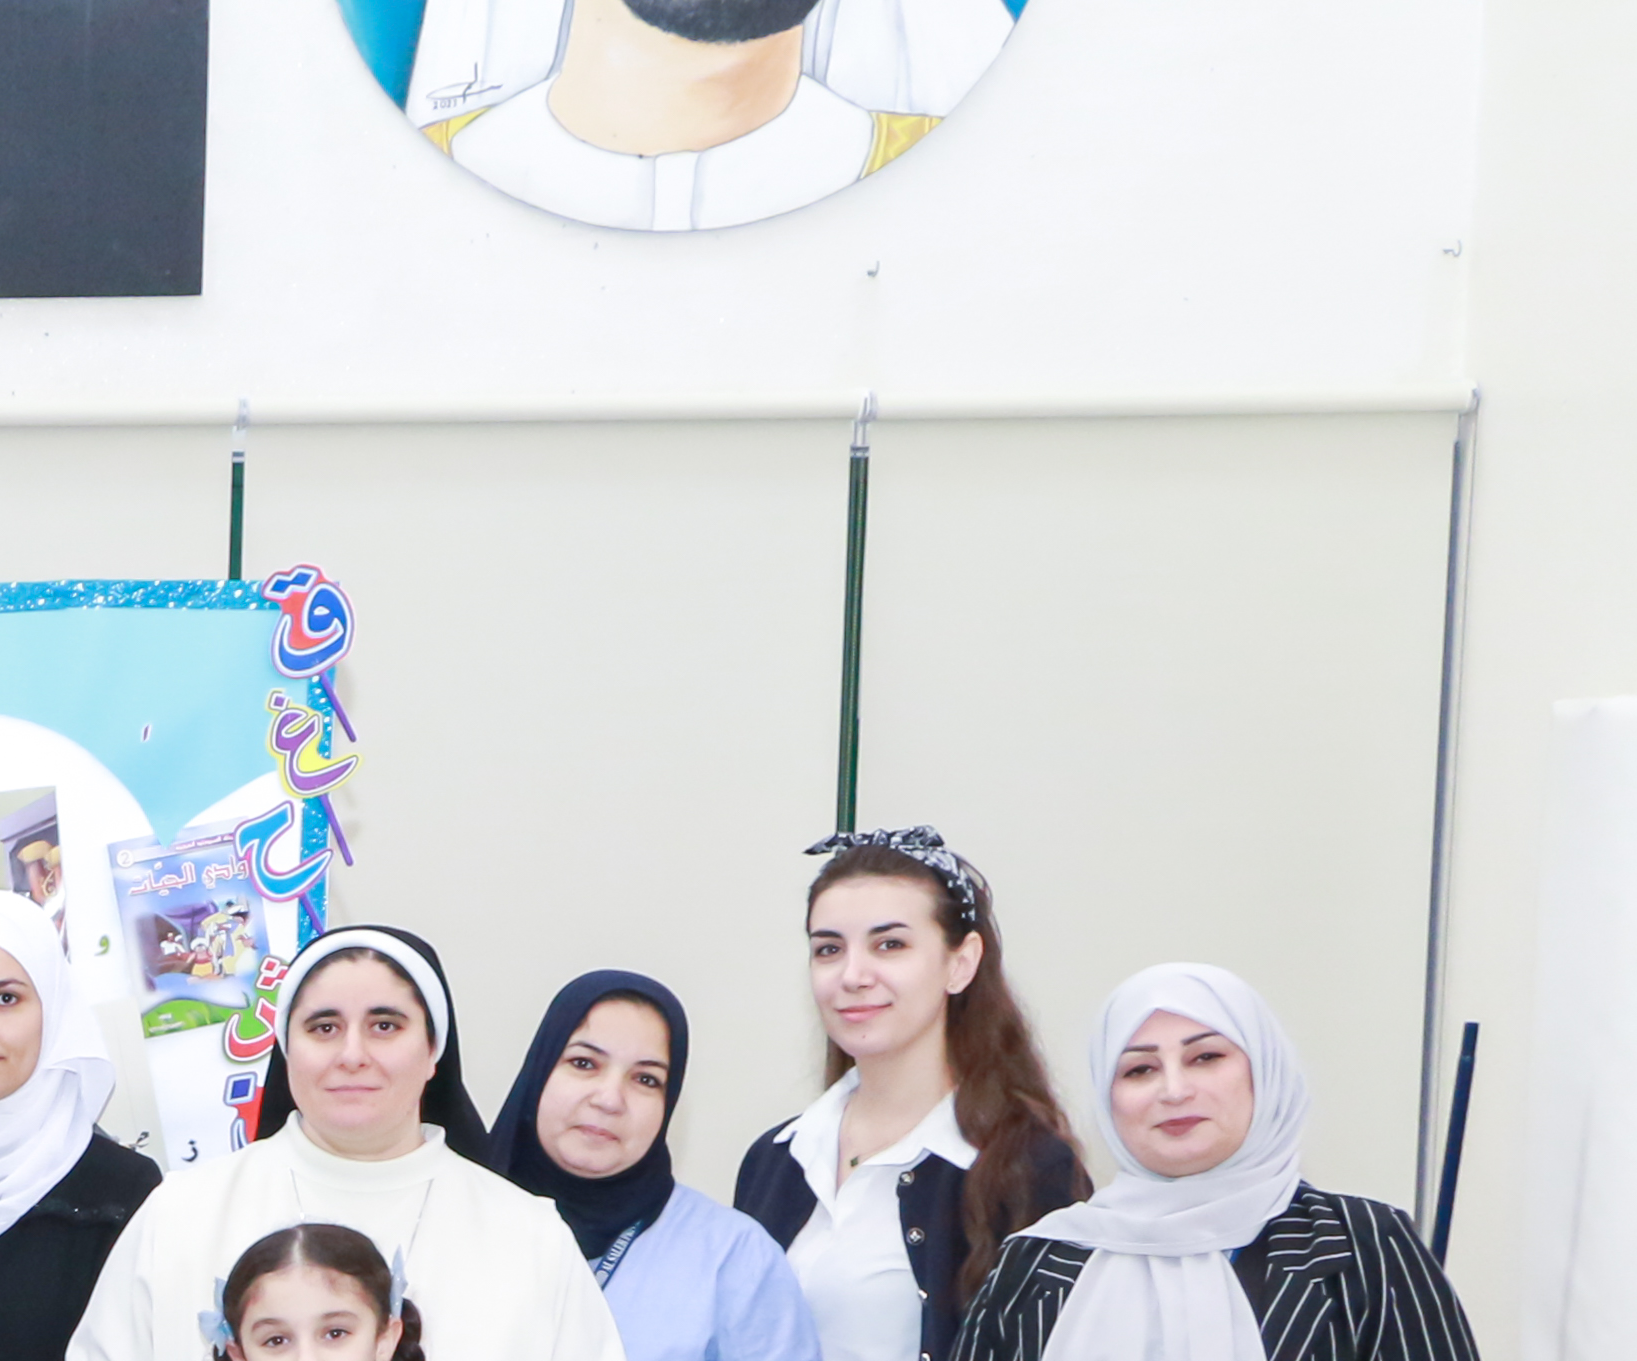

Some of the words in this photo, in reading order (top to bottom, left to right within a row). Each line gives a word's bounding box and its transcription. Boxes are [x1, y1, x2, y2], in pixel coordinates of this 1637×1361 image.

[263, 564, 355, 677] ق
[267, 690, 359, 794] غ
[234, 800, 333, 898] ح
[94, 934, 110, 957] و
[181, 1138, 200, 1164] ز
